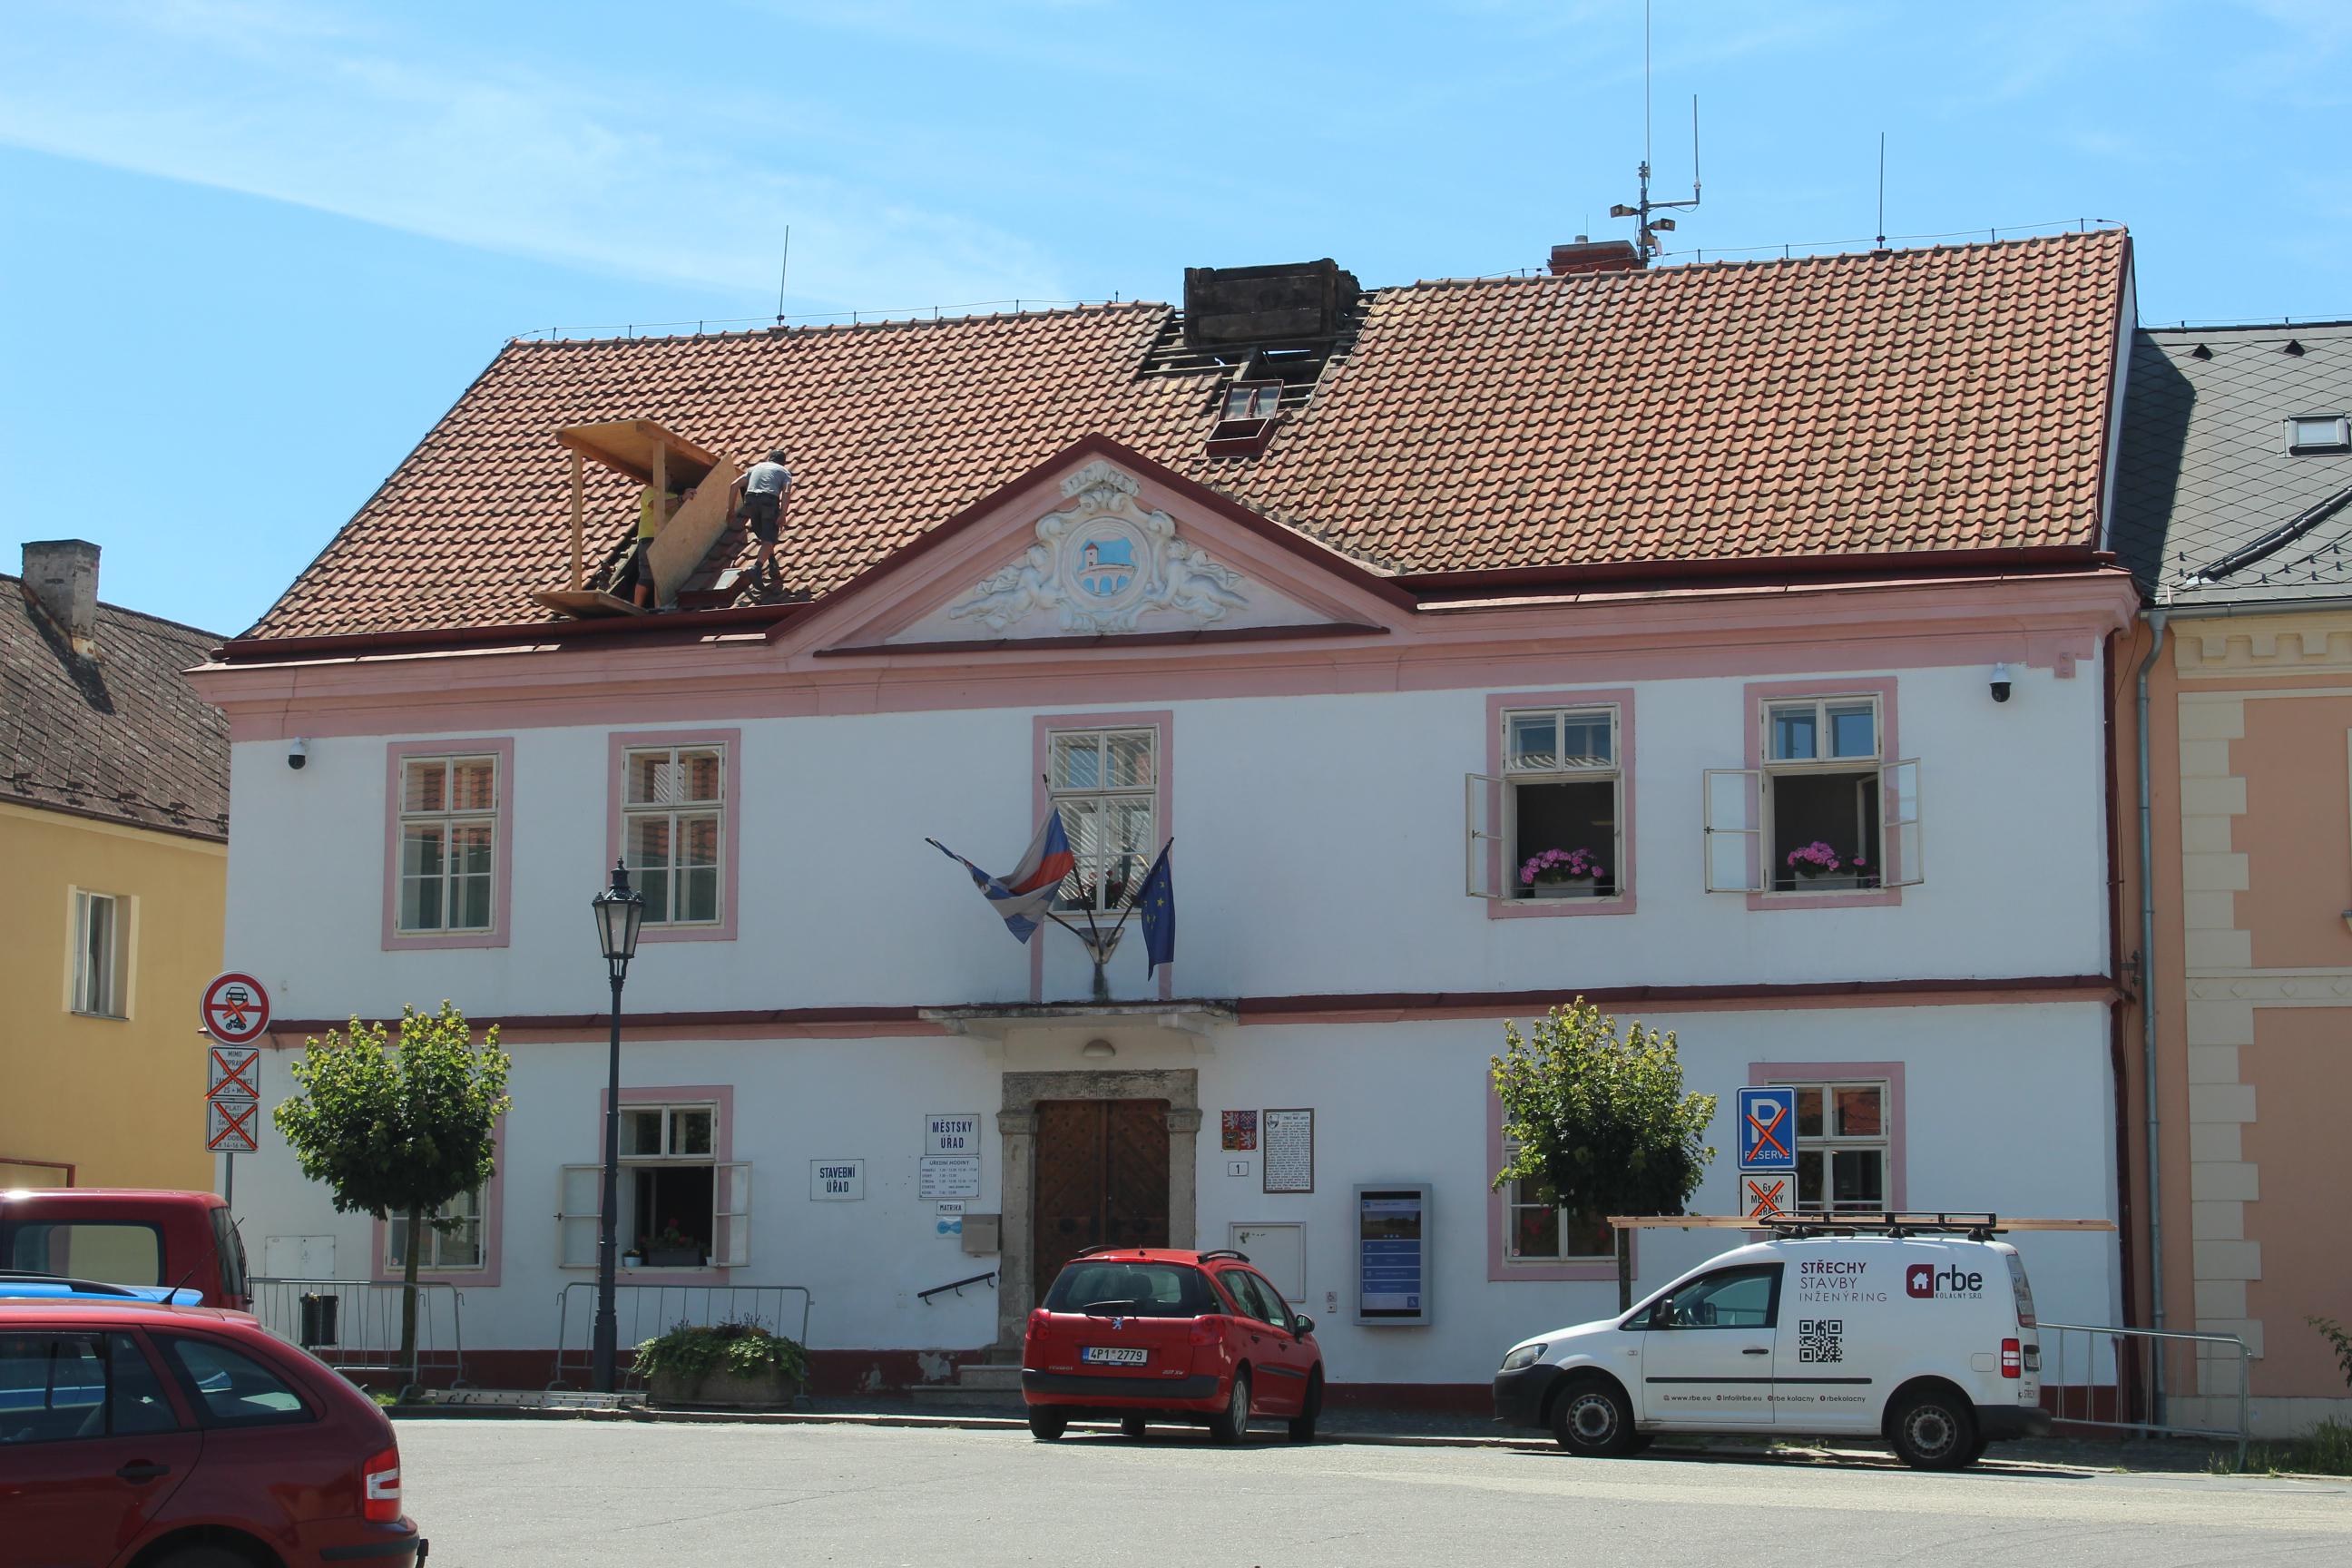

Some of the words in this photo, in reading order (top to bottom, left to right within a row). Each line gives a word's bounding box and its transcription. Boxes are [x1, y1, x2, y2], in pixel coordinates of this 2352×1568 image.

[932, 1119, 973, 1133] MĚSTSKÝ
[1751, 1098, 1782, 1143] P
[940, 1134, 964, 1149] ÚŘAD
[1744, 1148, 1790, 1160] RSERVÉ
[819, 1164, 856, 1179] STAVEBNÍ
[826, 1179, 849, 1193] ÚŘAD
[1750, 1192, 1784, 1204] MSKÝ
[1800, 1259, 1867, 1274] STŘECHY
[1800, 1277, 1857, 1289] STAVBY
[1799, 1290, 1887, 1302] INŽENÝRING
[1090, 1349, 1110, 1360] 4P1
[1117, 1350, 1142, 1361] 2779
[1826, 1395, 1867, 1403] rbekolacny
